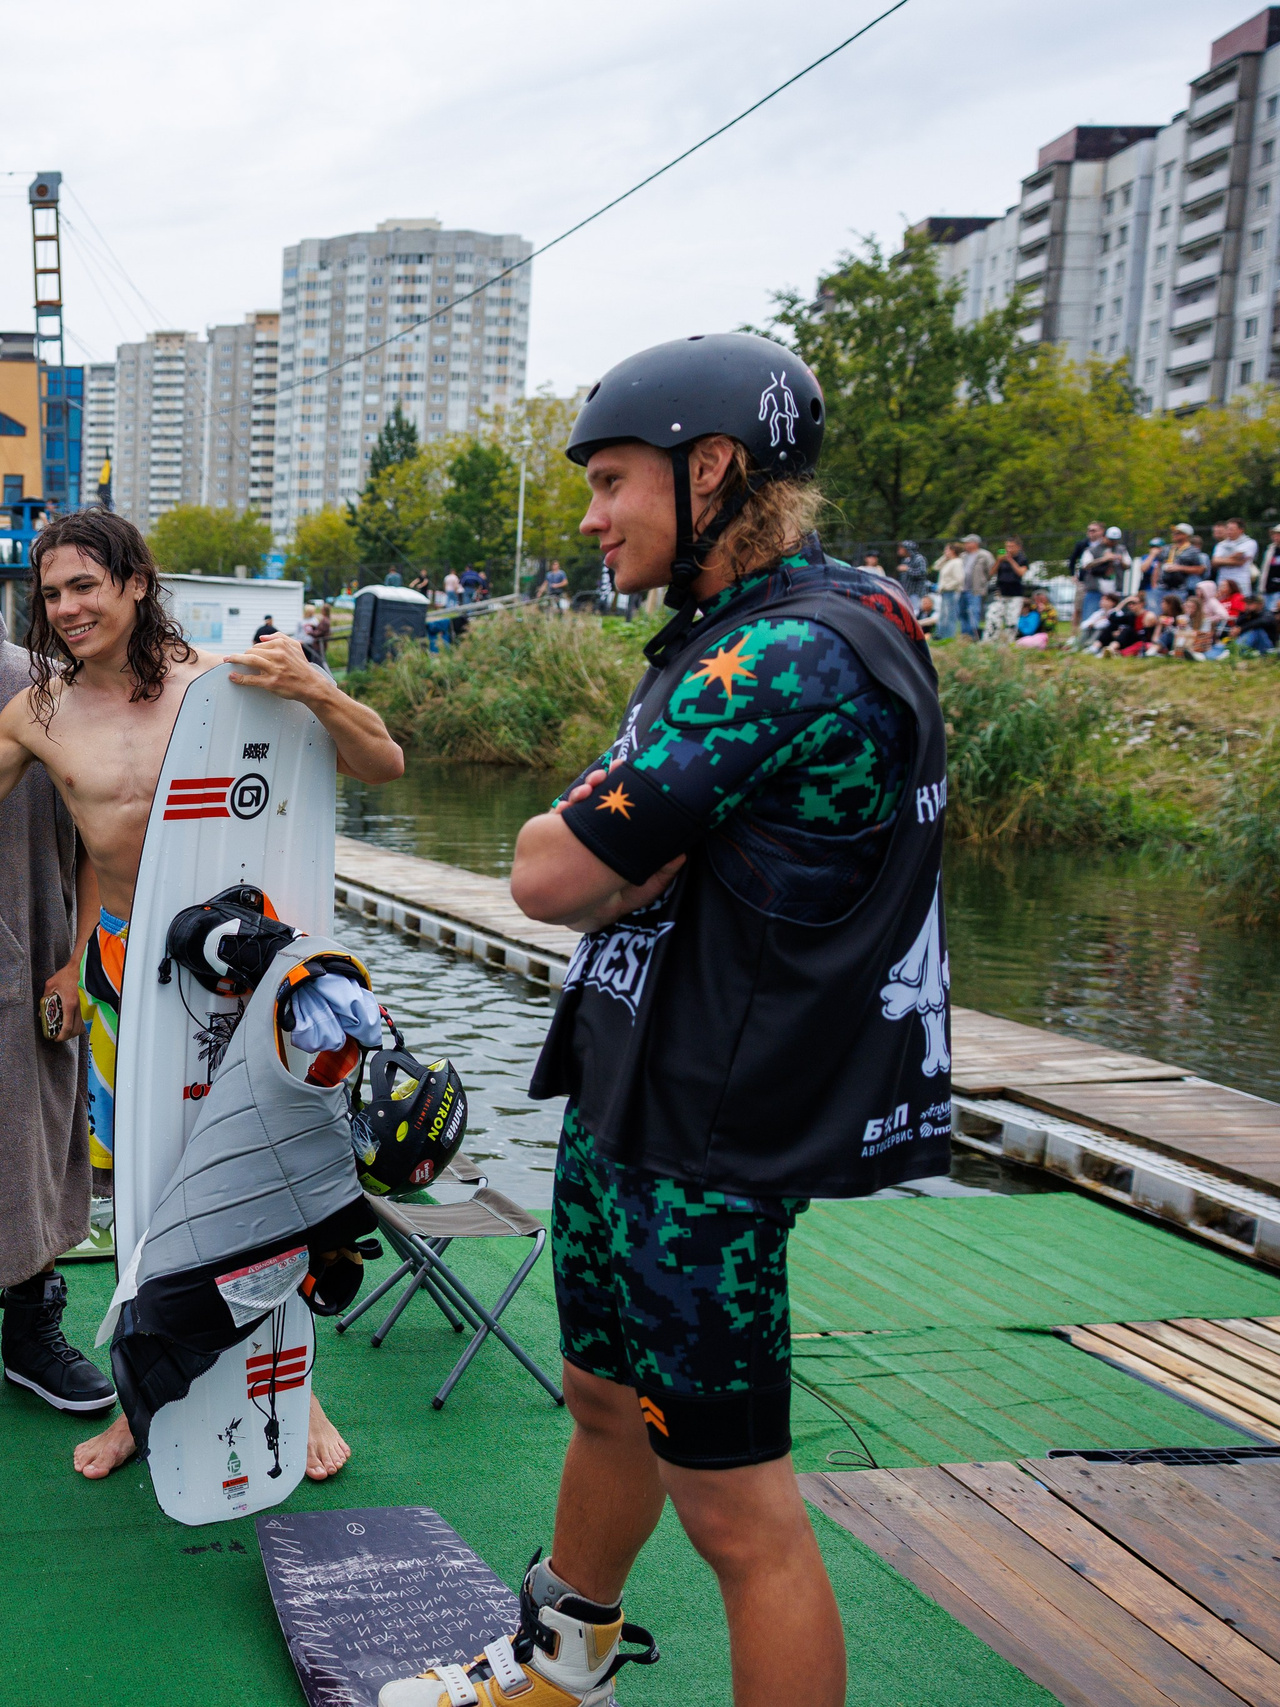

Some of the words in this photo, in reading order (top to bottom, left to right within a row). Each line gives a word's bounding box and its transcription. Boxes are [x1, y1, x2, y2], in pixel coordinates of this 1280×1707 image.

[243, 742, 270, 751] LINKIN
[242, 749, 268, 764] PARK
[861, 1128, 914, 1158] АВТОСЕРВИС
[254, 1258, 278, 1271] DANGER
